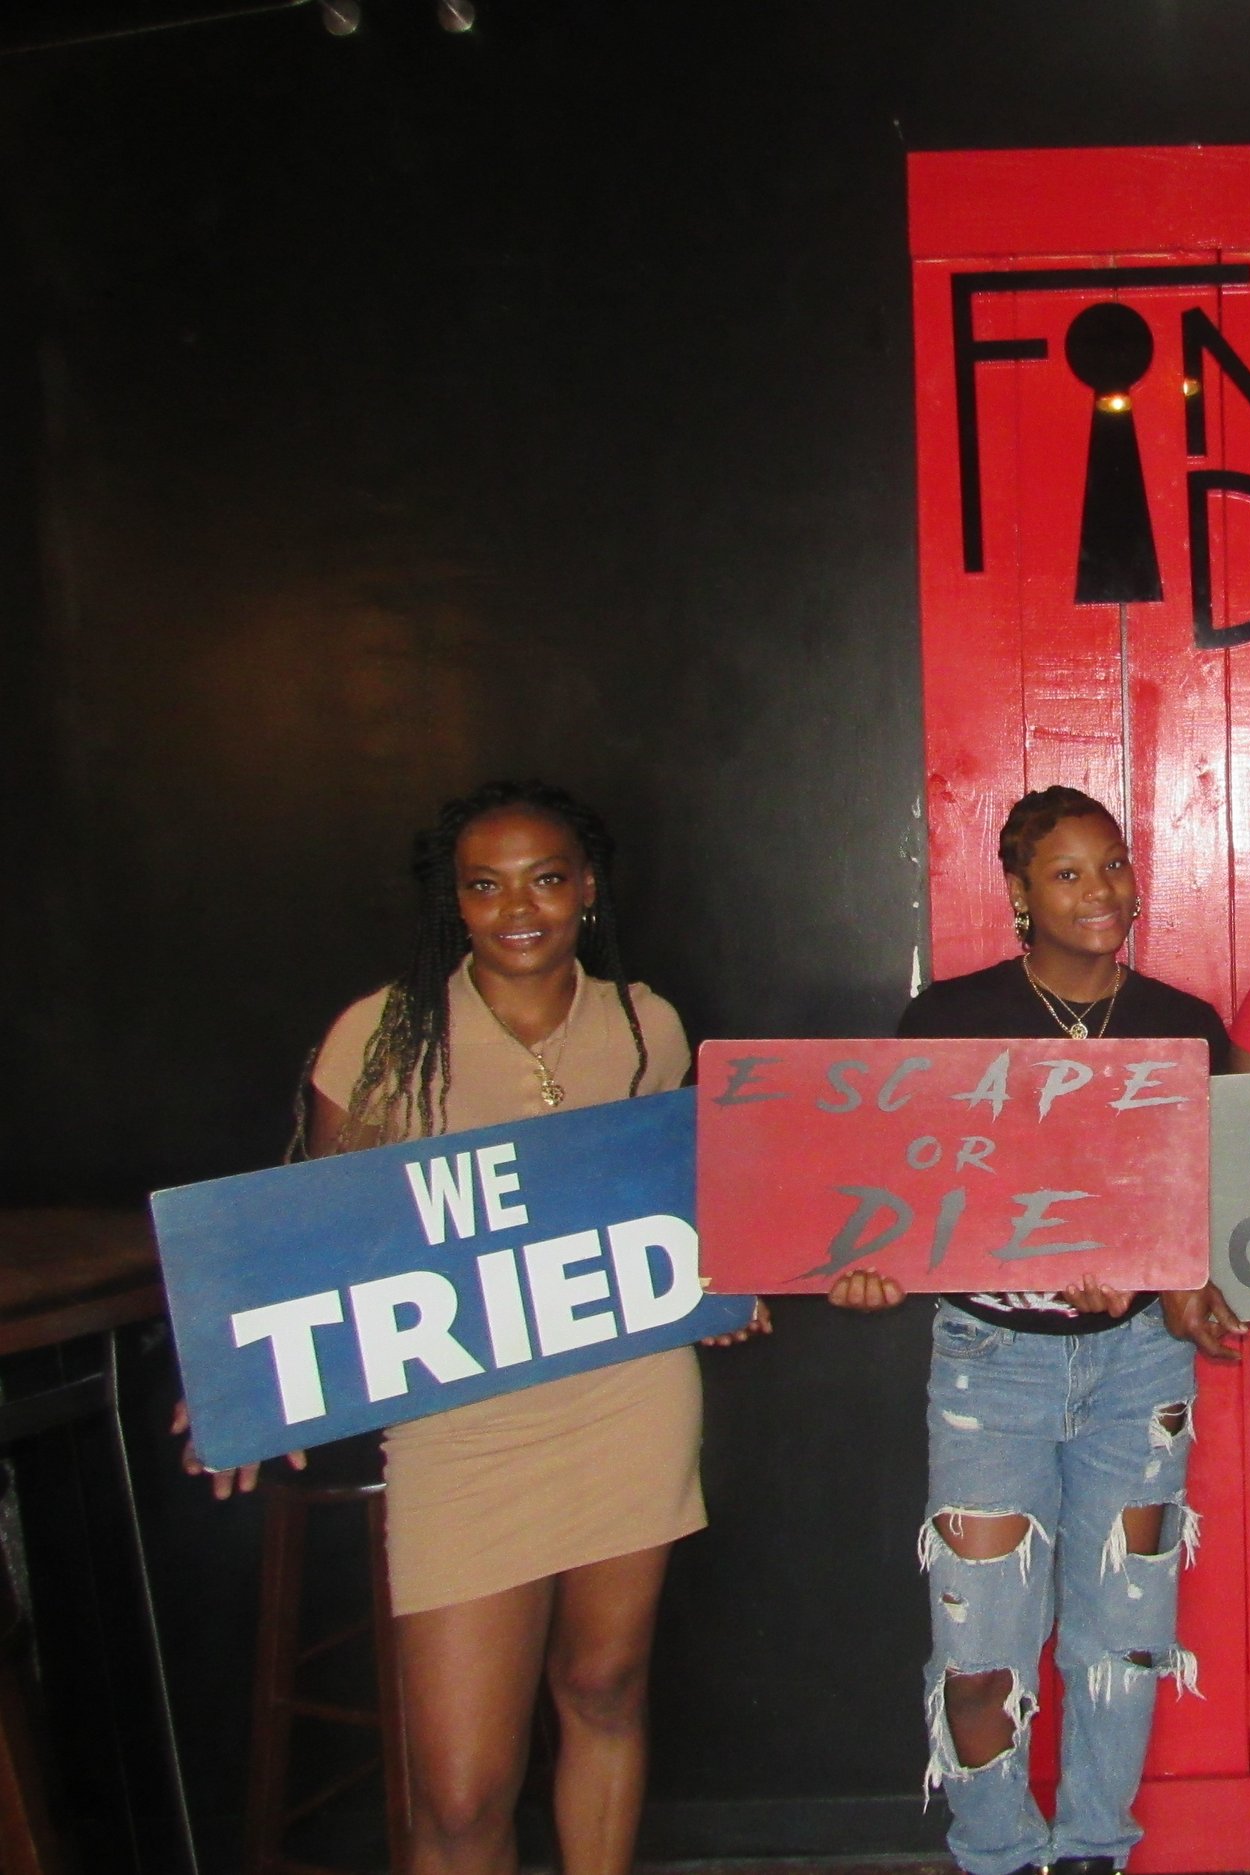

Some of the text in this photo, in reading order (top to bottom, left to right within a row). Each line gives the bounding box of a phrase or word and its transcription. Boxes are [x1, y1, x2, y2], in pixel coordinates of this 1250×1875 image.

[711, 1048, 1191, 1123] ESCAPE
[405, 1142, 529, 1246] WE
[905, 1135, 998, 1175] OR
[778, 1184, 1118, 1284] DIE
[231, 1214, 703, 1426] TRIED
